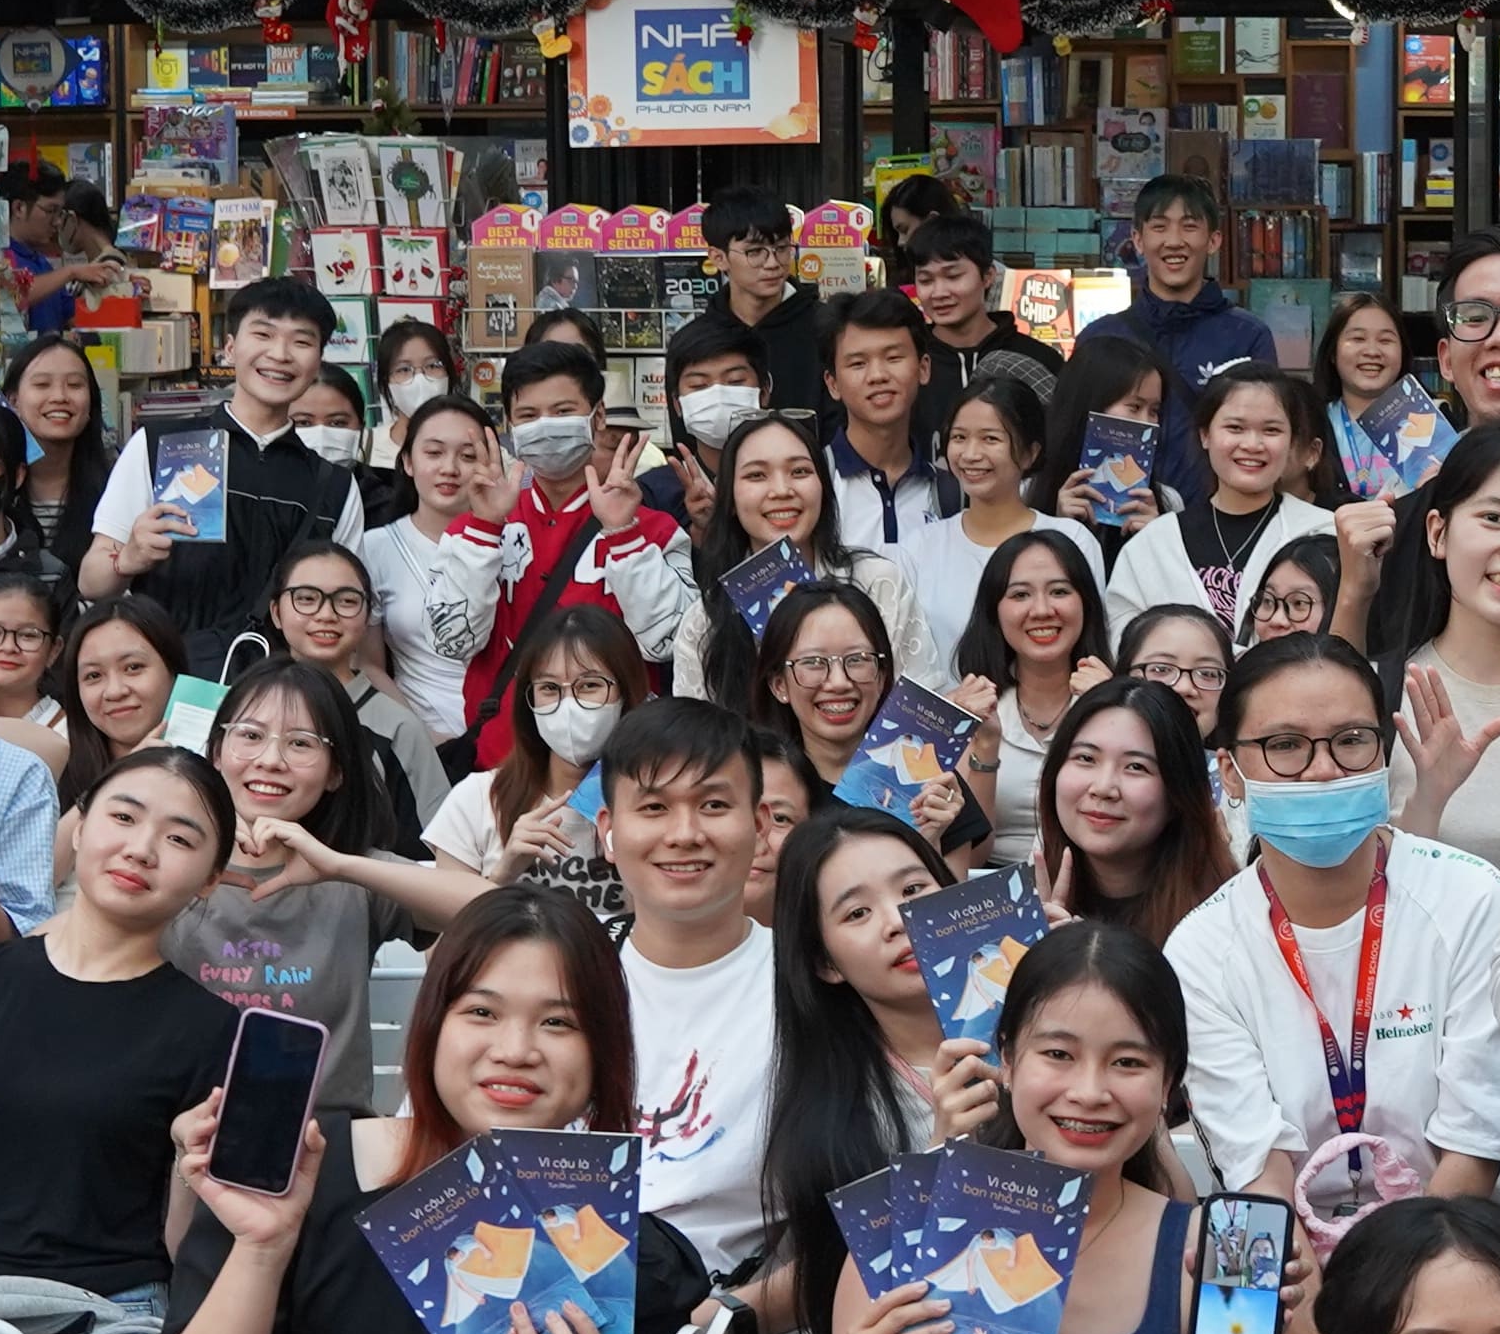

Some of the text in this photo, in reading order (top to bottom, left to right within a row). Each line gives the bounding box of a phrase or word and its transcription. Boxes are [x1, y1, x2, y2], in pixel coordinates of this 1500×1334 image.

[642, 53, 743, 96] SÁCH
[713, 103, 751, 113] NAM
[657, 215, 664, 228] 3
[855, 212, 864, 224] 6
[487, 227, 519, 237] BEST
[554, 226, 585, 237] BEST
[615, 227, 647, 238] BEST
[681, 226, 702, 238] BES
[815, 224, 846, 235] BEST
[480, 238, 526, 247] SELLER
[547, 237, 593, 248] SELLER
[608, 238, 655, 249] SELLER
[674, 238, 708, 248] SELL
[808, 235, 854, 246] SELLER
[666, 278, 719, 295] 2030
[1026, 281, 1060, 302] HEAL
[1020, 297, 1057, 325] CHILD
[200, 962, 313, 985] EVERY RAIN
[1364, 939, 1380, 1017] BUSINESS SCHOOL
[282, 993, 295, 1008] A
[1356, 998, 1364, 1016] THE
[538, 1156, 590, 1170] Vì cậu là
[516, 1169, 541, 1181] bạn
[963, 1183, 988, 1198] bạn
[988, 1175, 1039, 1198] Vì cậu là
